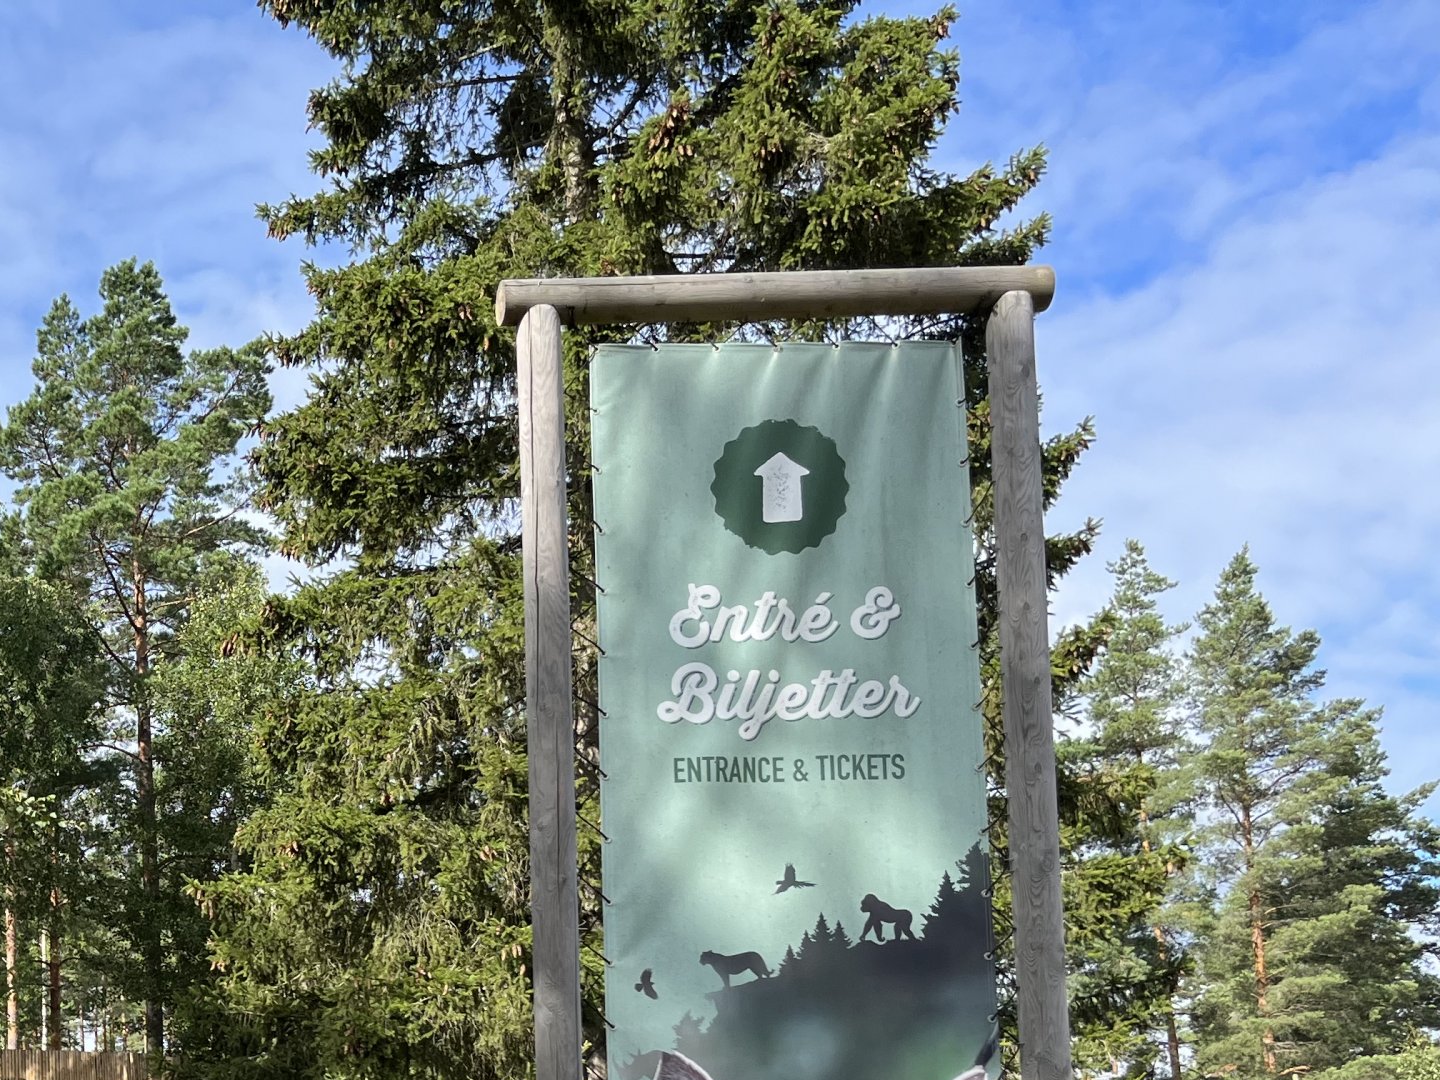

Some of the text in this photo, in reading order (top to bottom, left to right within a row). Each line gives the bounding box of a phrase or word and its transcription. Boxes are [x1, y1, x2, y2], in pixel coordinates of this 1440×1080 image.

[669, 583, 901, 649] Entré &
[656, 661, 922, 741] Biljetter
[673, 753, 906, 783] ENTRANCE & TICKETS
